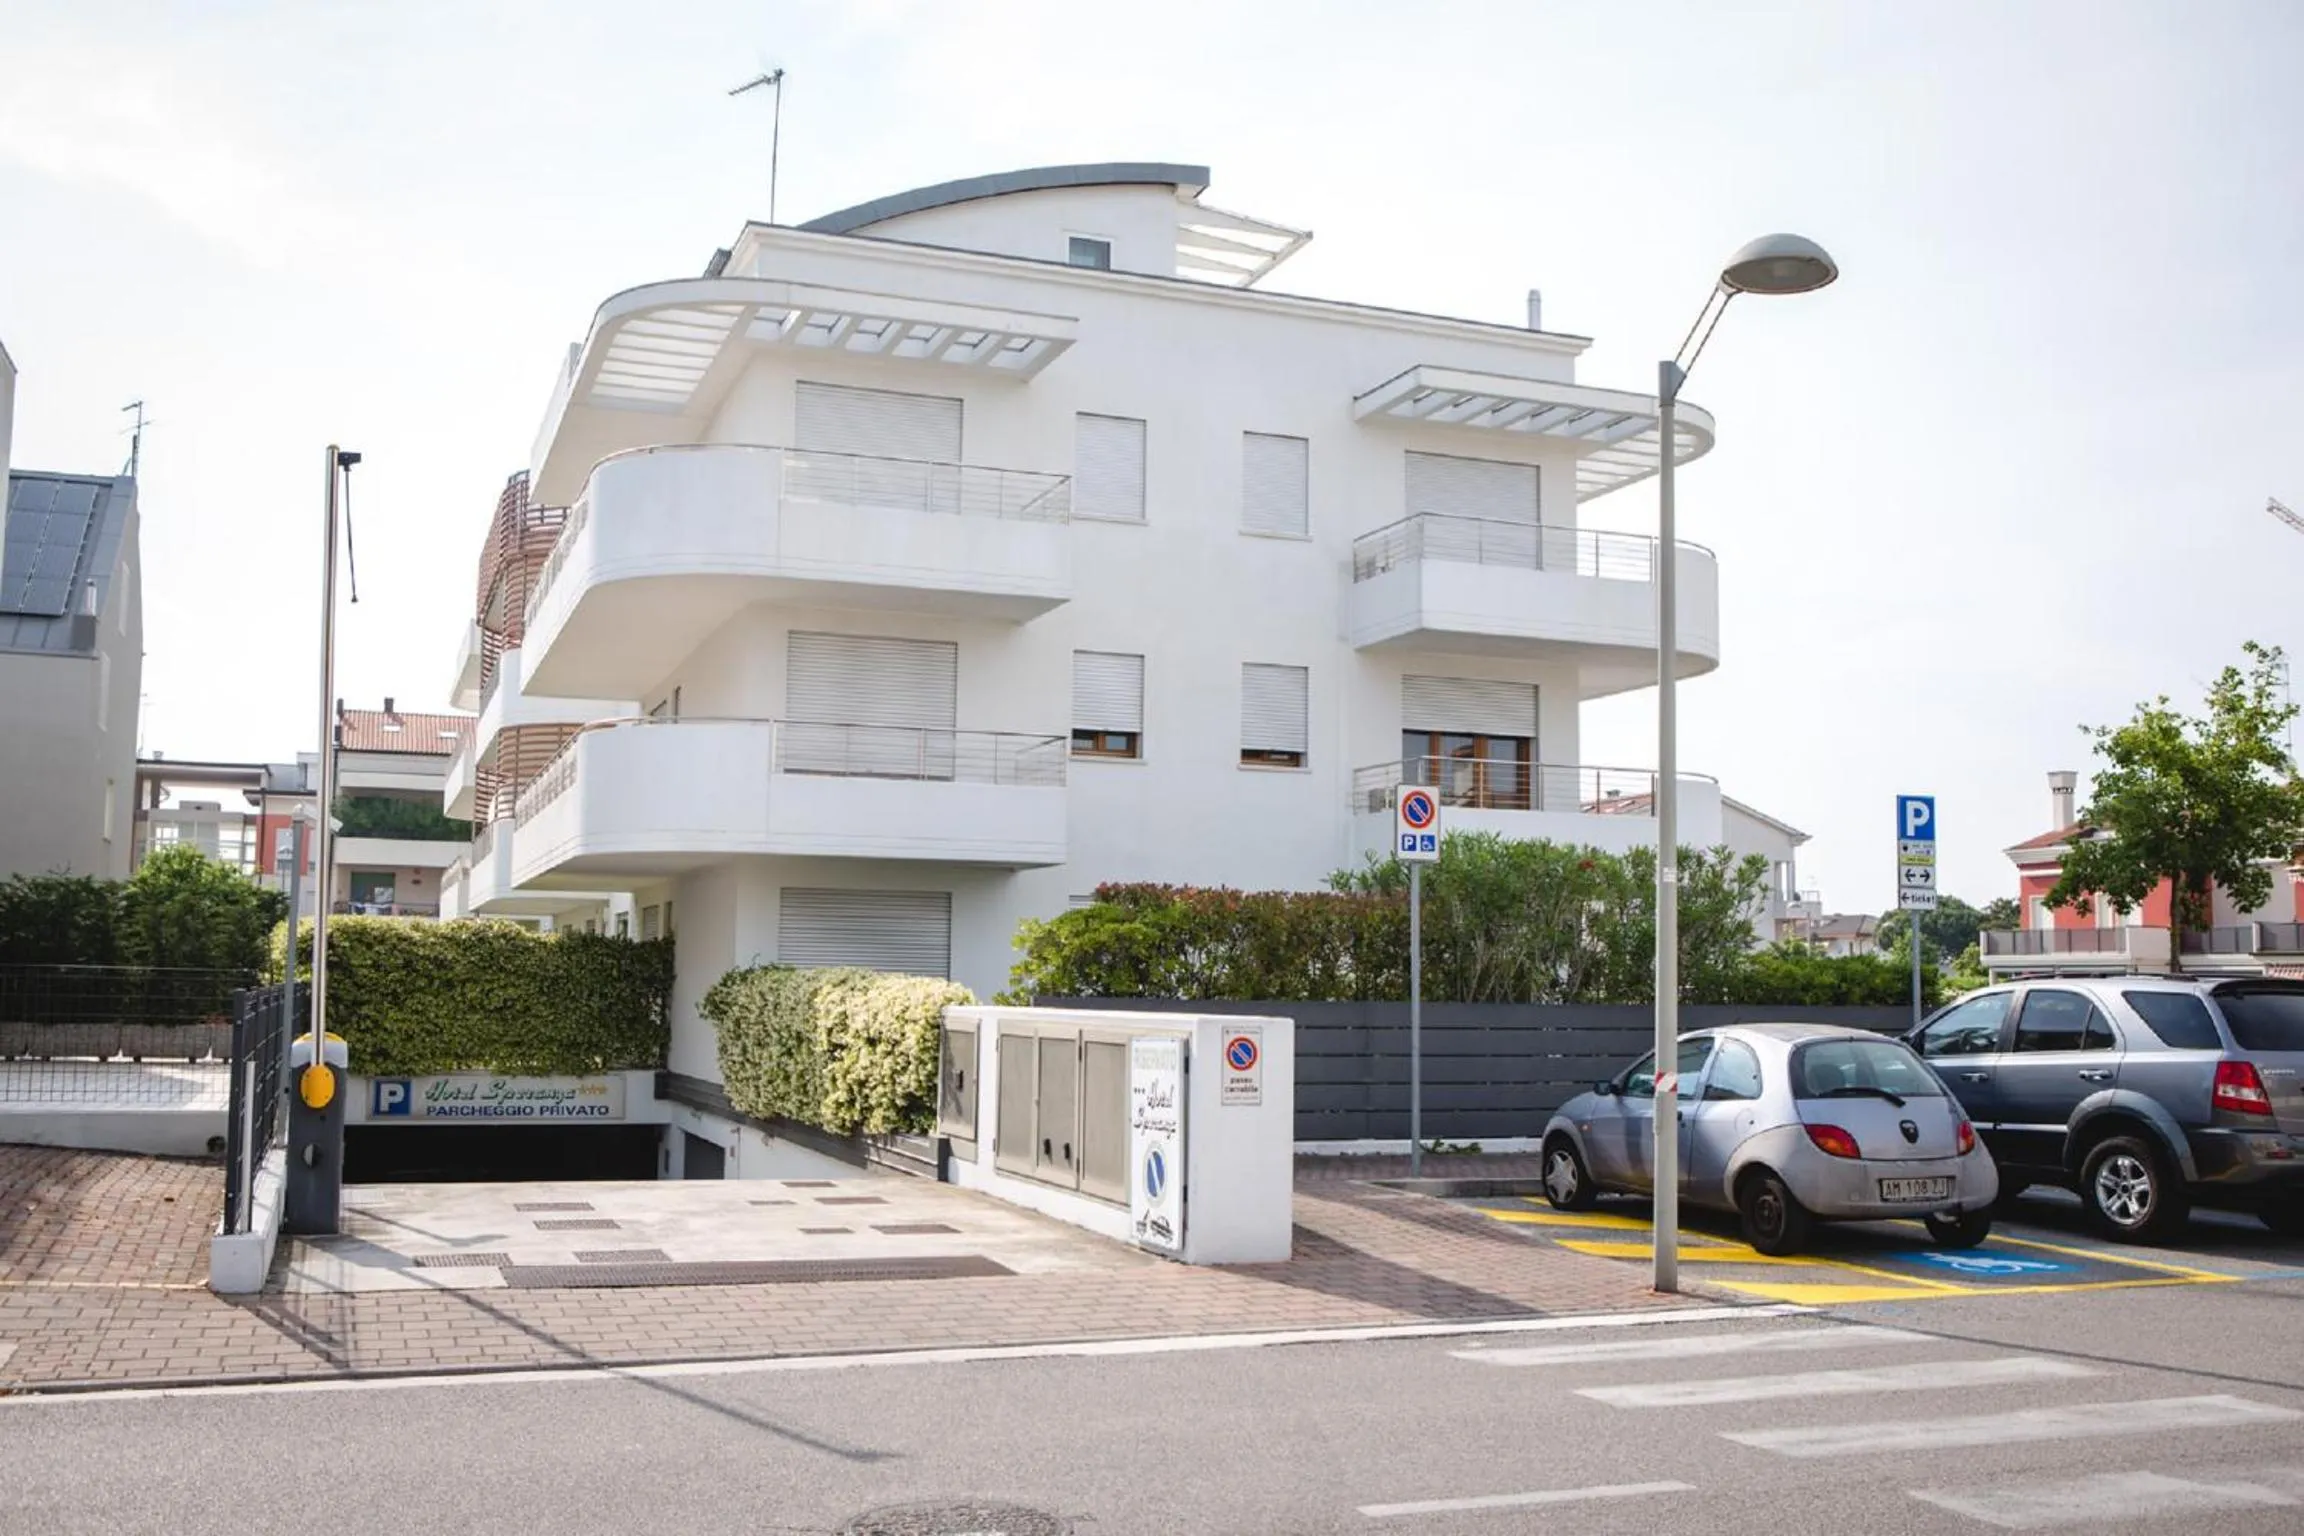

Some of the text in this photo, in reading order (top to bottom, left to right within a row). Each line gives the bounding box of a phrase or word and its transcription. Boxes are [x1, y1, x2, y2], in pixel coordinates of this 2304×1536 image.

[1905, 800, 1930, 836] P
[1403, 836, 1414, 850] P
[380, 1083, 405, 1112] P
[425, 1079, 477, 1101] Hotel
[426, 1105, 610, 1117] PARCHEGGIO PRIVATO
[1885, 1181, 1901, 1197] AM
[1906, 1181, 1928, 1196] 108
